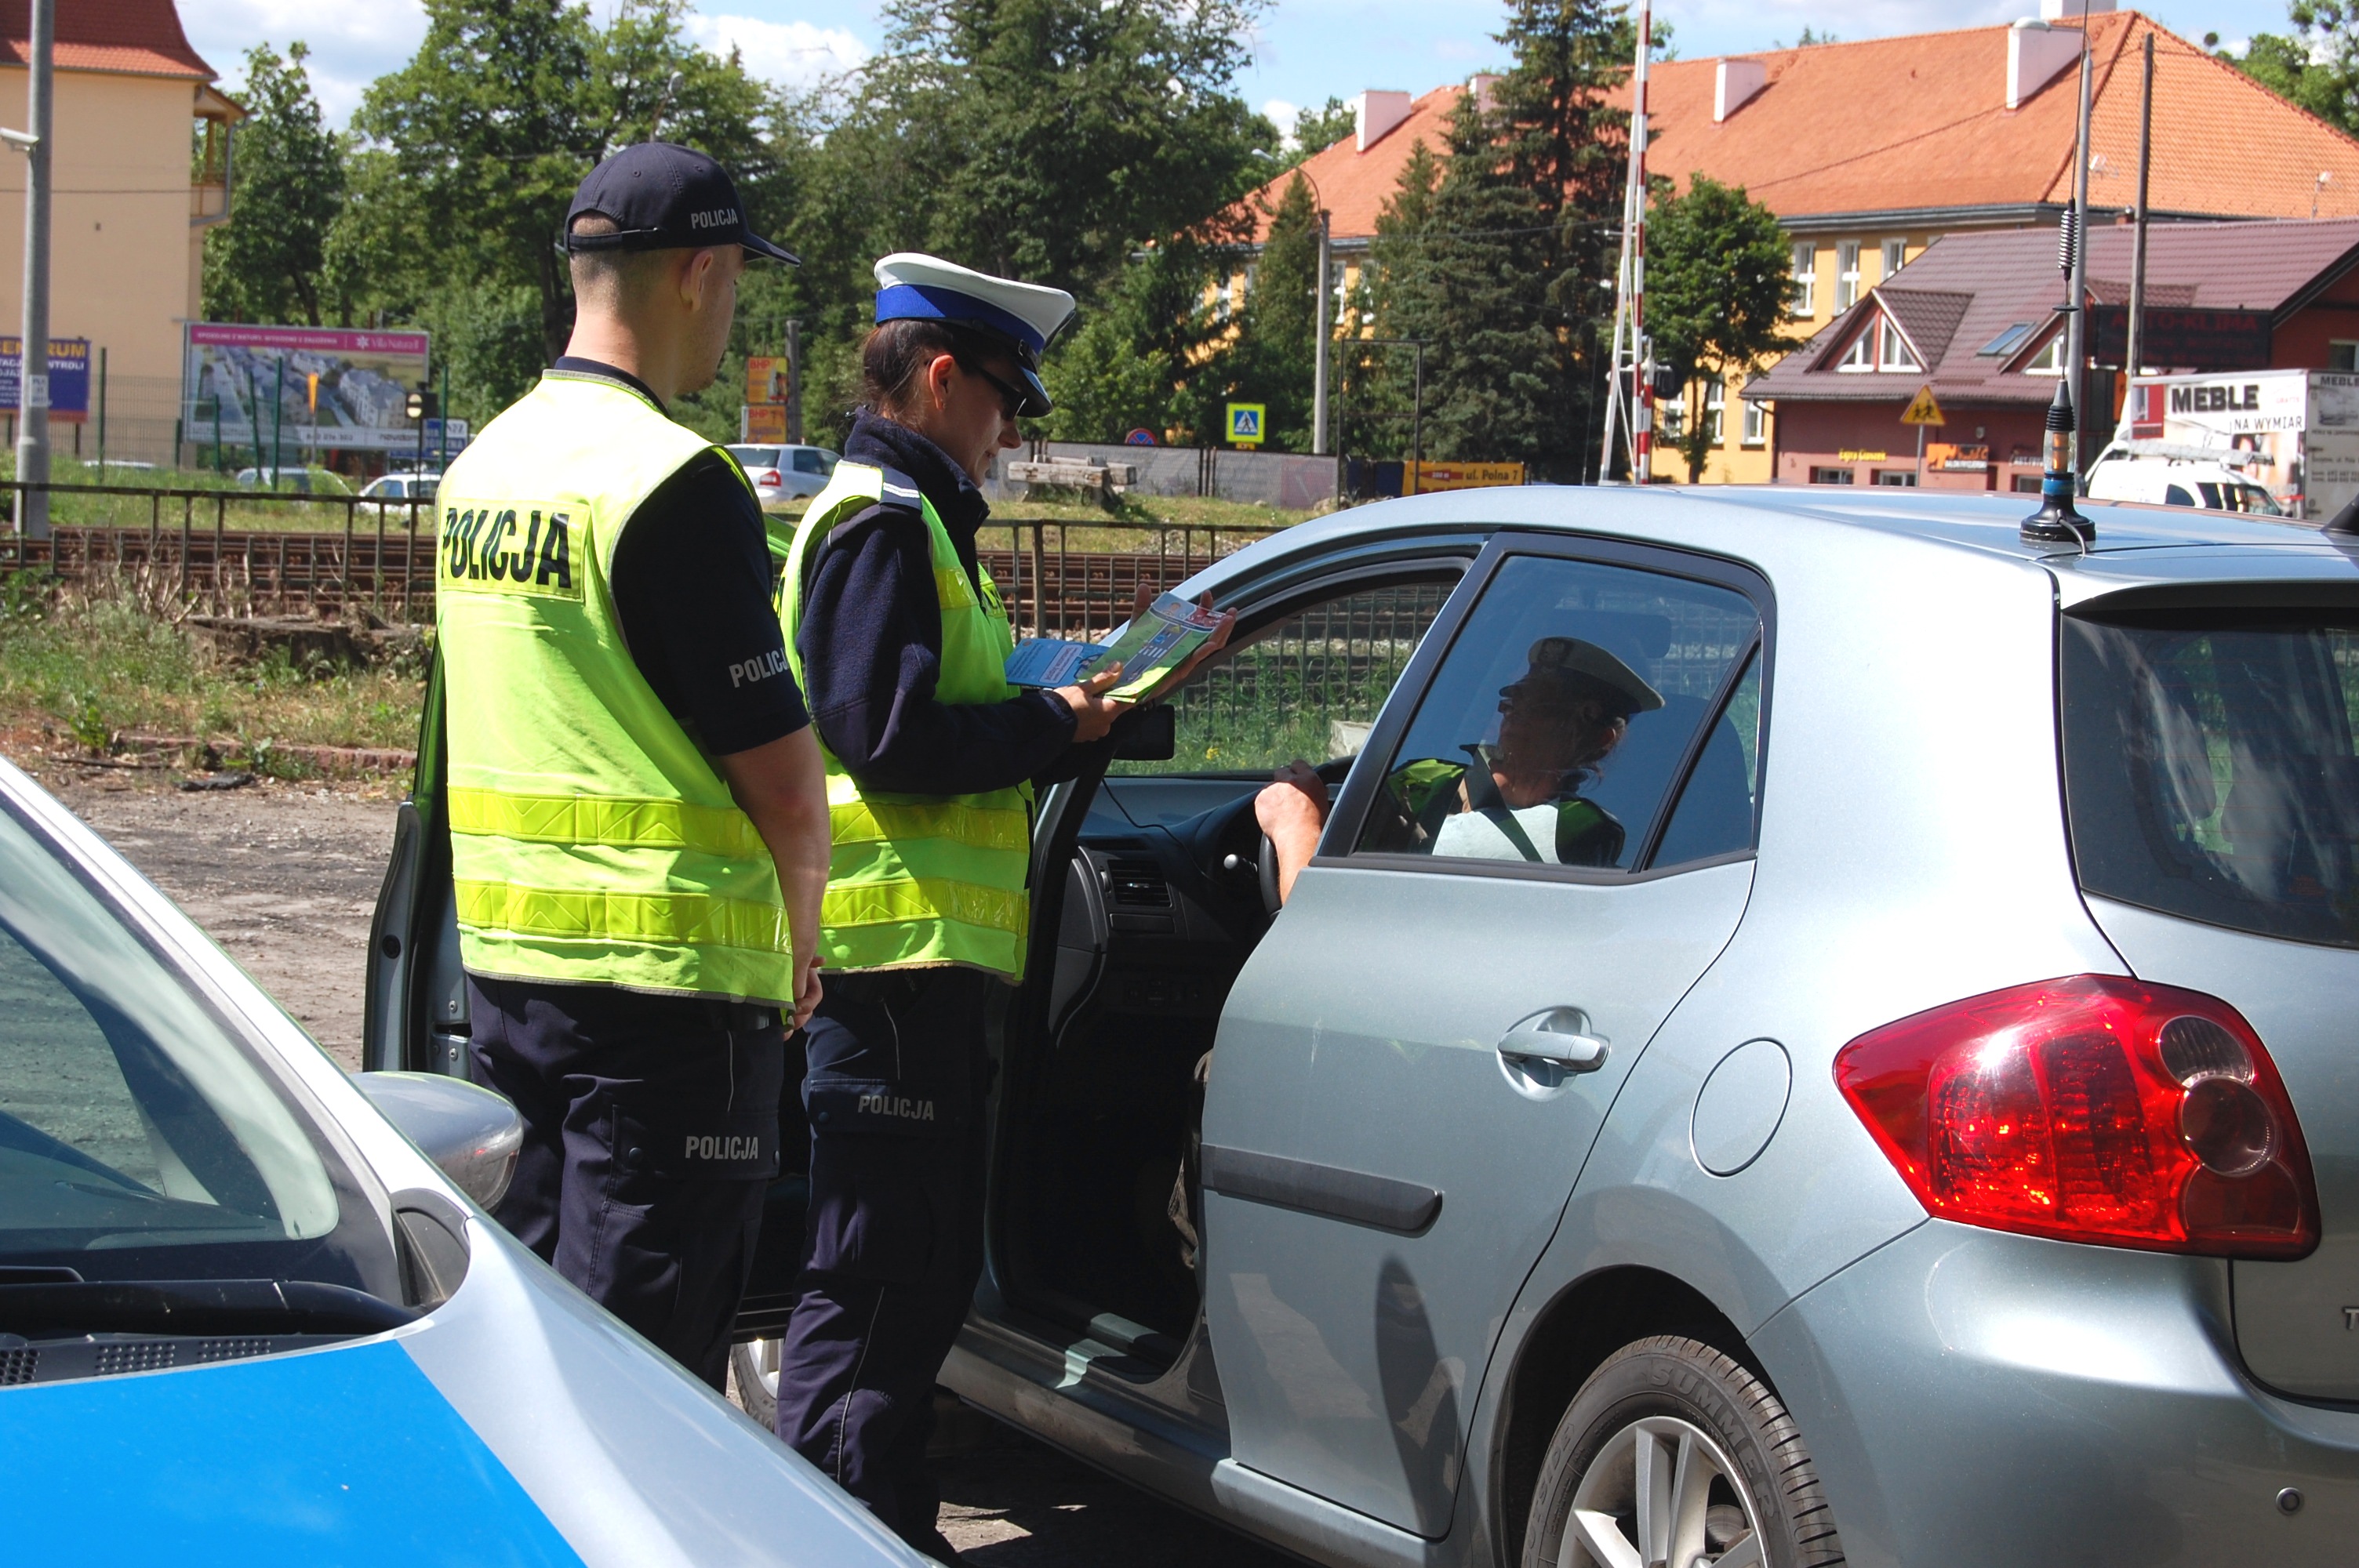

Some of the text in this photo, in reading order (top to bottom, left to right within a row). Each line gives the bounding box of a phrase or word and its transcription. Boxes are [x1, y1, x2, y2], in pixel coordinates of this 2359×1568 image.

[690, 208, 739, 229] POLICJA
[2110, 313, 2258, 331] ATO-KLIMA
[750, 359, 770, 370] BHP
[2319, 376, 2359, 387] MEBLE
[2172, 384, 2259, 414] MEBLE
[2234, 416, 2303, 430] NA WYMIAR
[1466, 470, 1518, 481] ul. Polna 7
[442, 507, 572, 590] POLICJA
[729, 647, 789, 688] POLICJ
[857, 1094, 935, 1121] POLICJA
[685, 1136, 759, 1160] POLICJA
[1650, 1363, 1782, 1523] SUMMER
